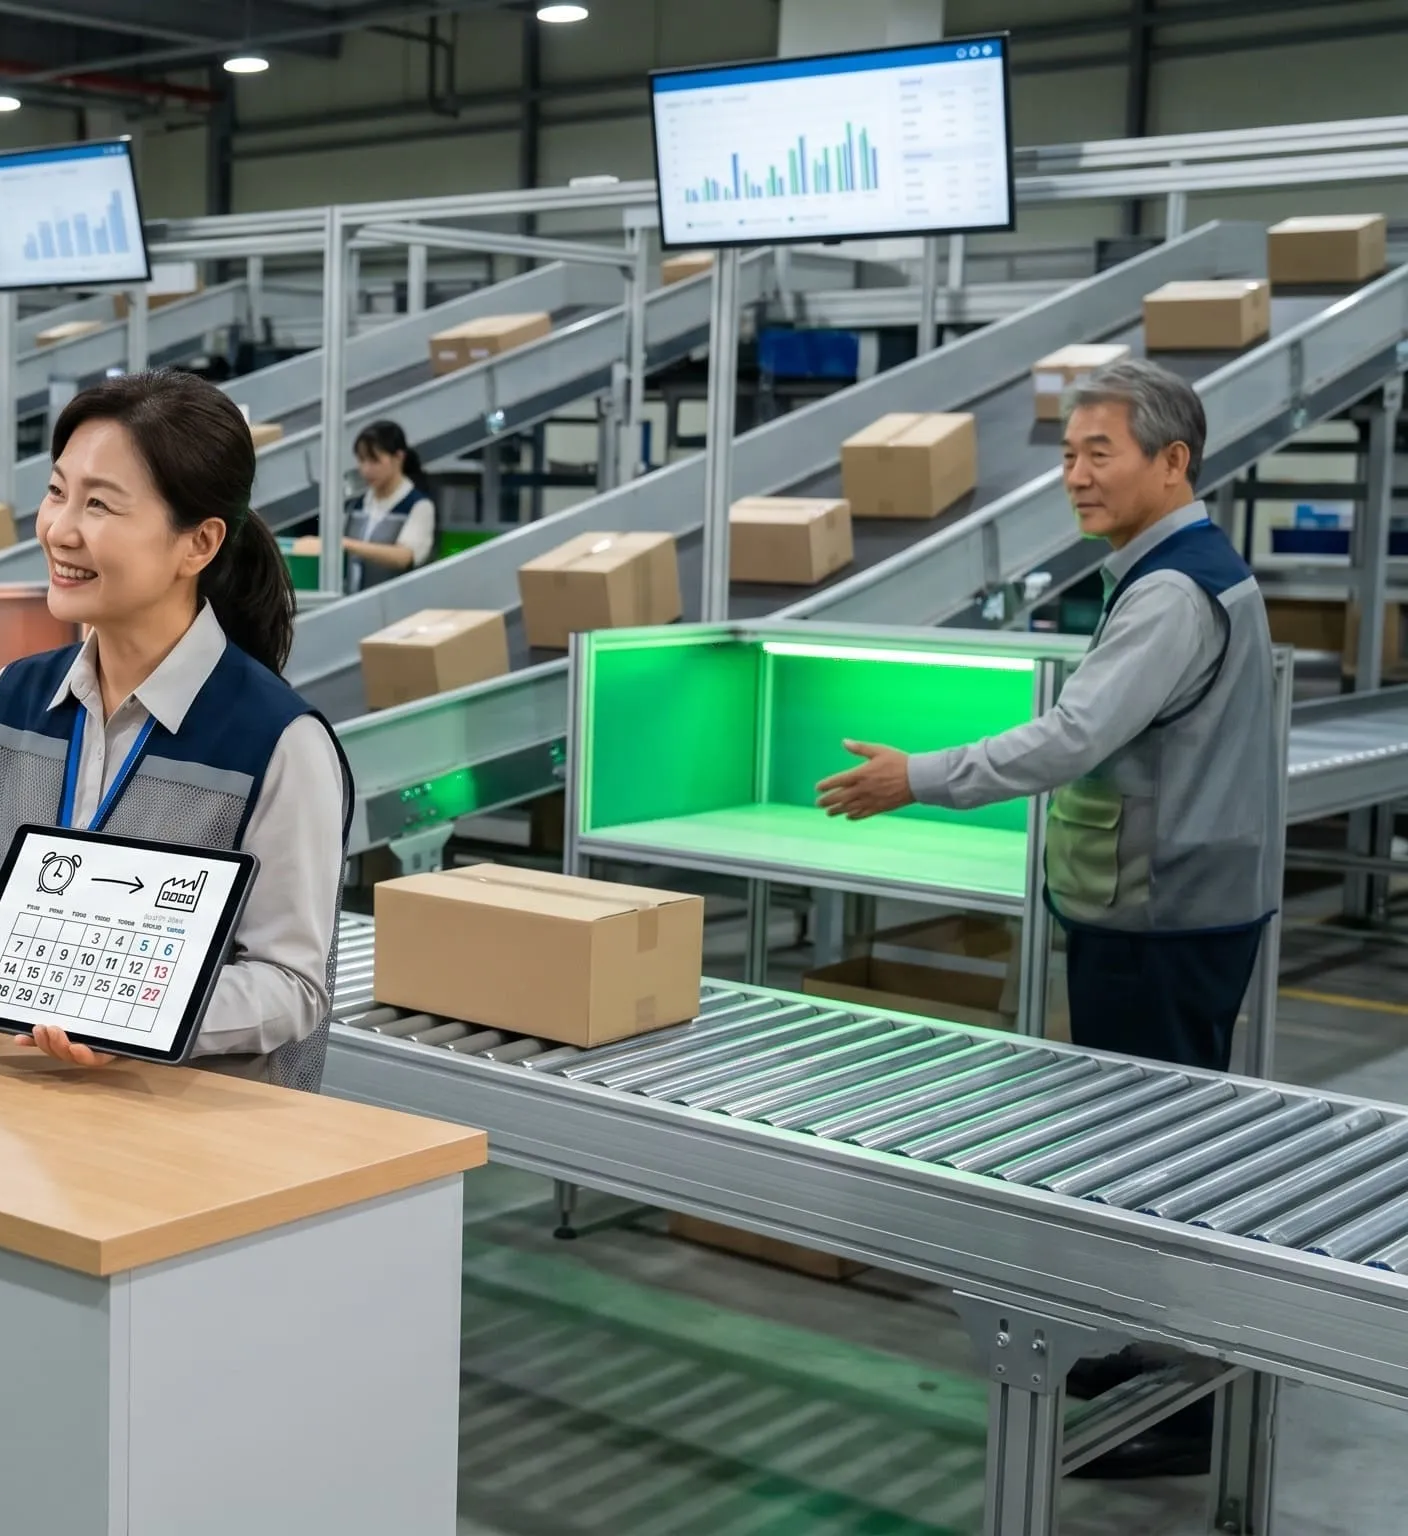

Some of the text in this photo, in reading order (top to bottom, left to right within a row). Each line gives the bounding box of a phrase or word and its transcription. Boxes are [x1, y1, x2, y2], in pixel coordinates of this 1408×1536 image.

[91, 932, 173, 956] 3 4 5 6
[14, 940, 168, 979] 7 8 9 10 11 12 13
[3, 961, 17, 975] 14
[26, 966, 41, 979] 15
[49, 970, 63, 983] 16
[94, 978, 111, 993] 25
[117, 983, 136, 997] 26
[15, 987, 32, 1002] 29
[39, 992, 54, 1006] 31
